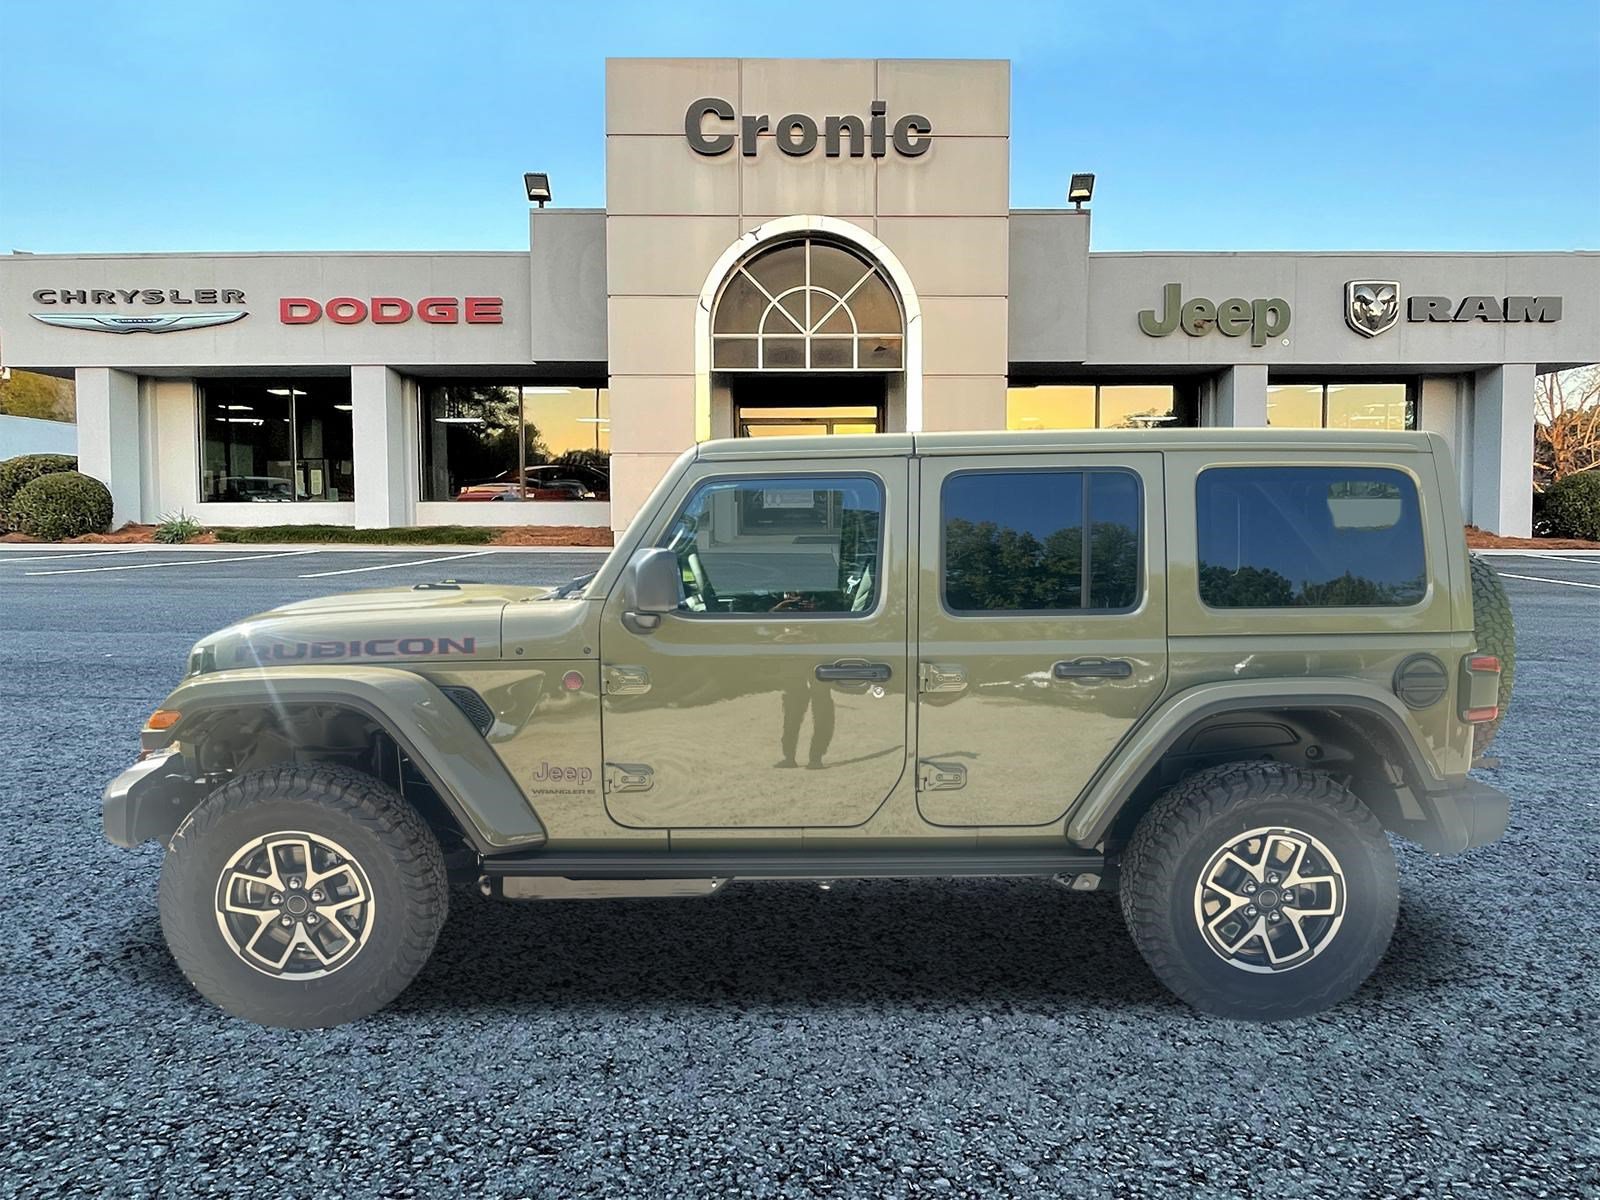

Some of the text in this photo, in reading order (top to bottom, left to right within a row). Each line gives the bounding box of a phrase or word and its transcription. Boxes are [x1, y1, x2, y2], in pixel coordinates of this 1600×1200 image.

[685, 97, 932, 157] Cronic
[32, 288, 247, 305] CHRYSLER
[1408, 296, 1563, 322] RAM
[279, 297, 503, 325] DODGE
[1138, 283, 1292, 347] Jeep
[235, 637, 476, 663] RUBICON
[533, 762, 593, 785] Jeep
